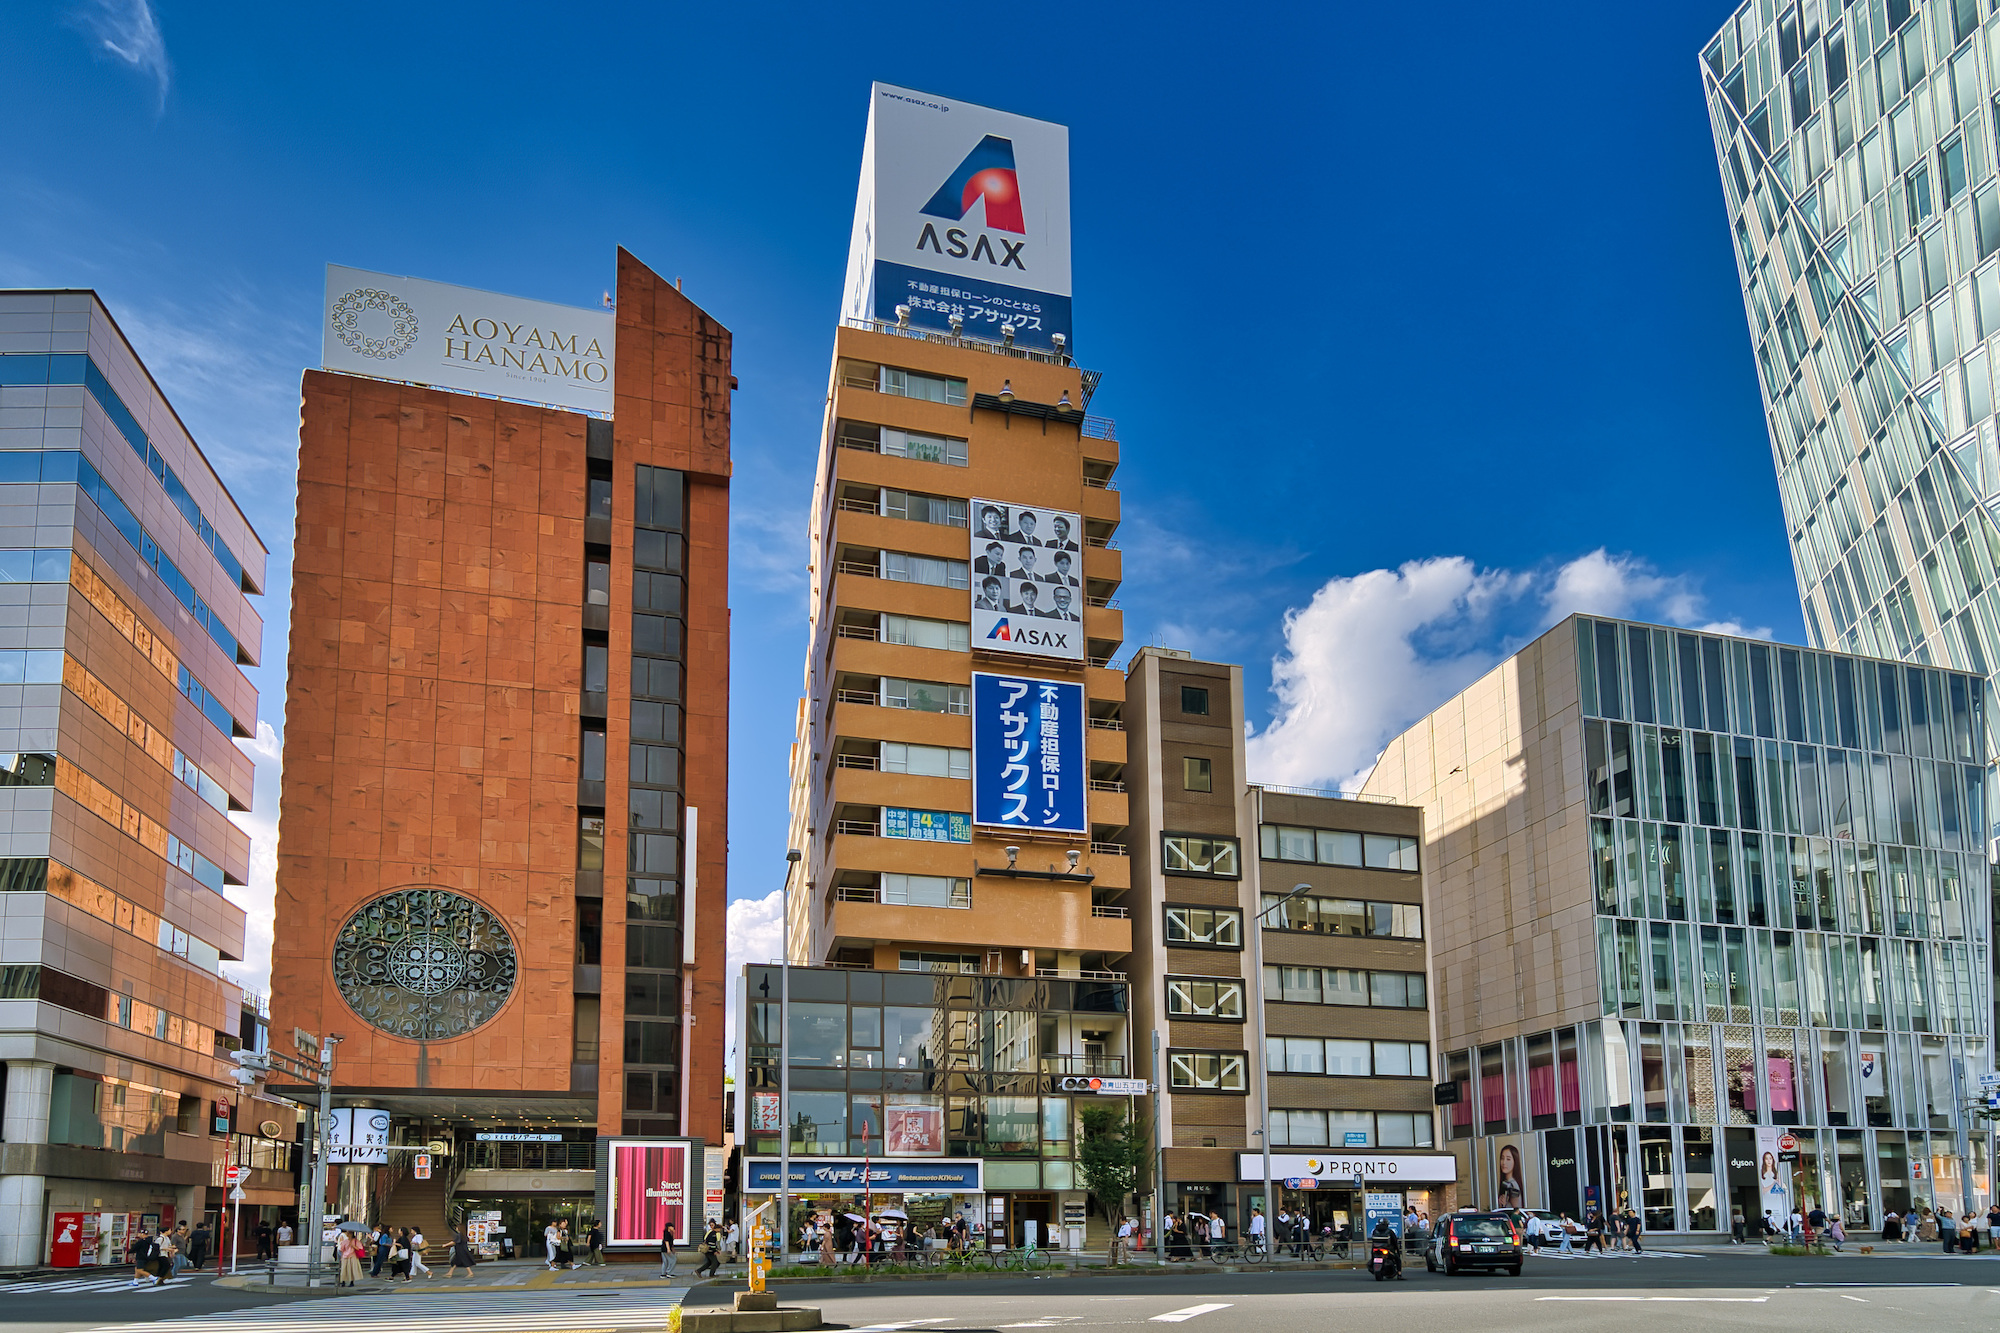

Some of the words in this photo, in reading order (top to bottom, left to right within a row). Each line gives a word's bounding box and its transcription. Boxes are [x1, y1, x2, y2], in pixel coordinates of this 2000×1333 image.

[881, 91, 950, 113] www.asax.co.jp
[916, 222, 1026, 271] ASAX
[907, 279, 1042, 314] 不動産担保ローンのことなら
[907, 295, 966, 316] 株式会社
[968, 304, 1042, 332] アサックス
[446, 313, 606, 360] AOYAMA
[444, 336, 608, 384] HANAMO
[505, 371, 526, 380] Since
[529, 375, 547, 384] 1904
[1014, 628, 1068, 649] ASAX
[998, 680, 1030, 823] アサックス
[1039, 684, 1060, 825] 不動産担保ローン
[888, 810, 907, 820] 中学
[920, 813, 933, 828] 4
[951, 816, 964, 824] 050
[888, 820, 907, 829] 受験
[951, 824, 970, 832] -5316
[910, 828, 948, 840] 勉強塾
[951, 832, 970, 840] -4423
[770, 1097, 778, 1122] テイク
[762, 1105, 770, 1130] アウト
[1330, 1161, 1398, 1174] PRONTO
[1550, 1157, 1574, 1168] dyson
[1731, 1158, 1754, 1169] dyson
[815, 1166, 892, 1184] マツモトキヨシ
[660, 1180, 681, 1190] Street
[646, 1188, 682, 1198] Illuminated
[661, 1197, 684, 1206] Panels.
